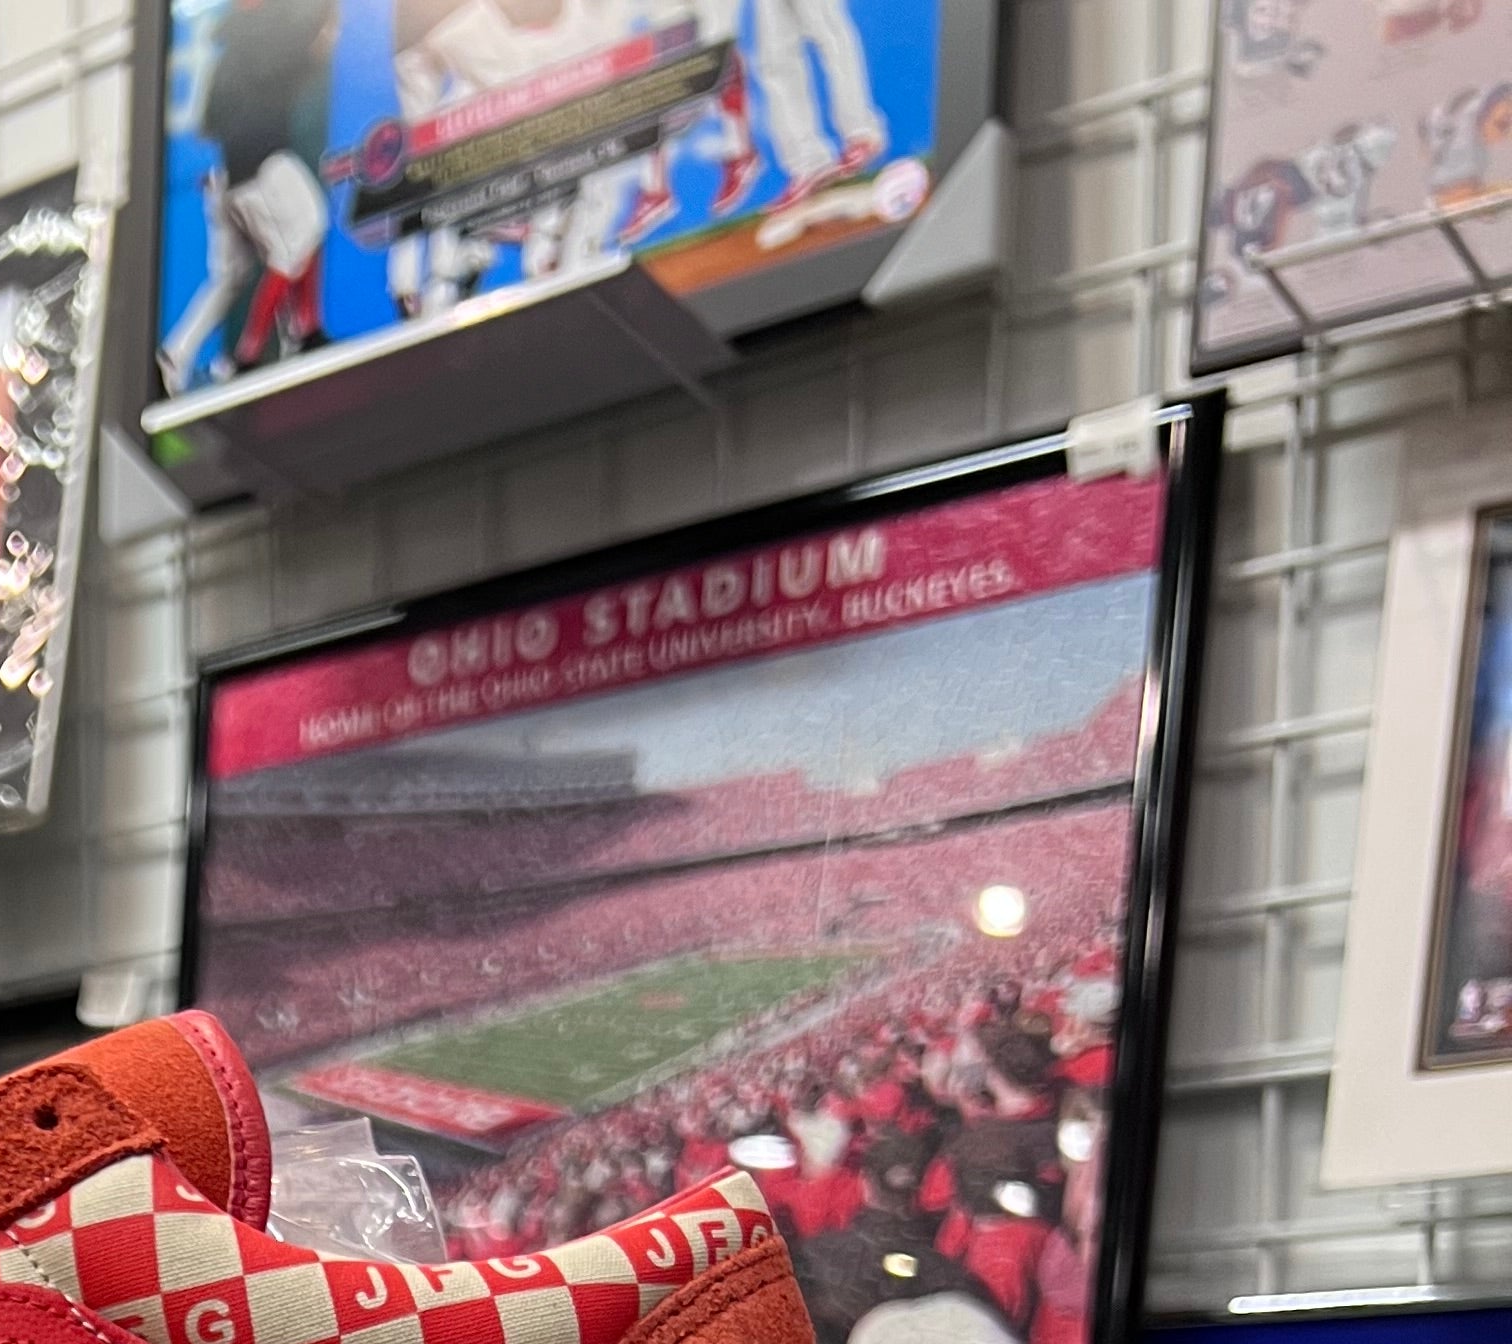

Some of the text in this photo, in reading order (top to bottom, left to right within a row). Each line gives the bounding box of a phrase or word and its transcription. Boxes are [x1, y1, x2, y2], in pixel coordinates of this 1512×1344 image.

[407, 526, 885, 687] OHIO STADIUM
[299, 702, 379, 749] HOME
